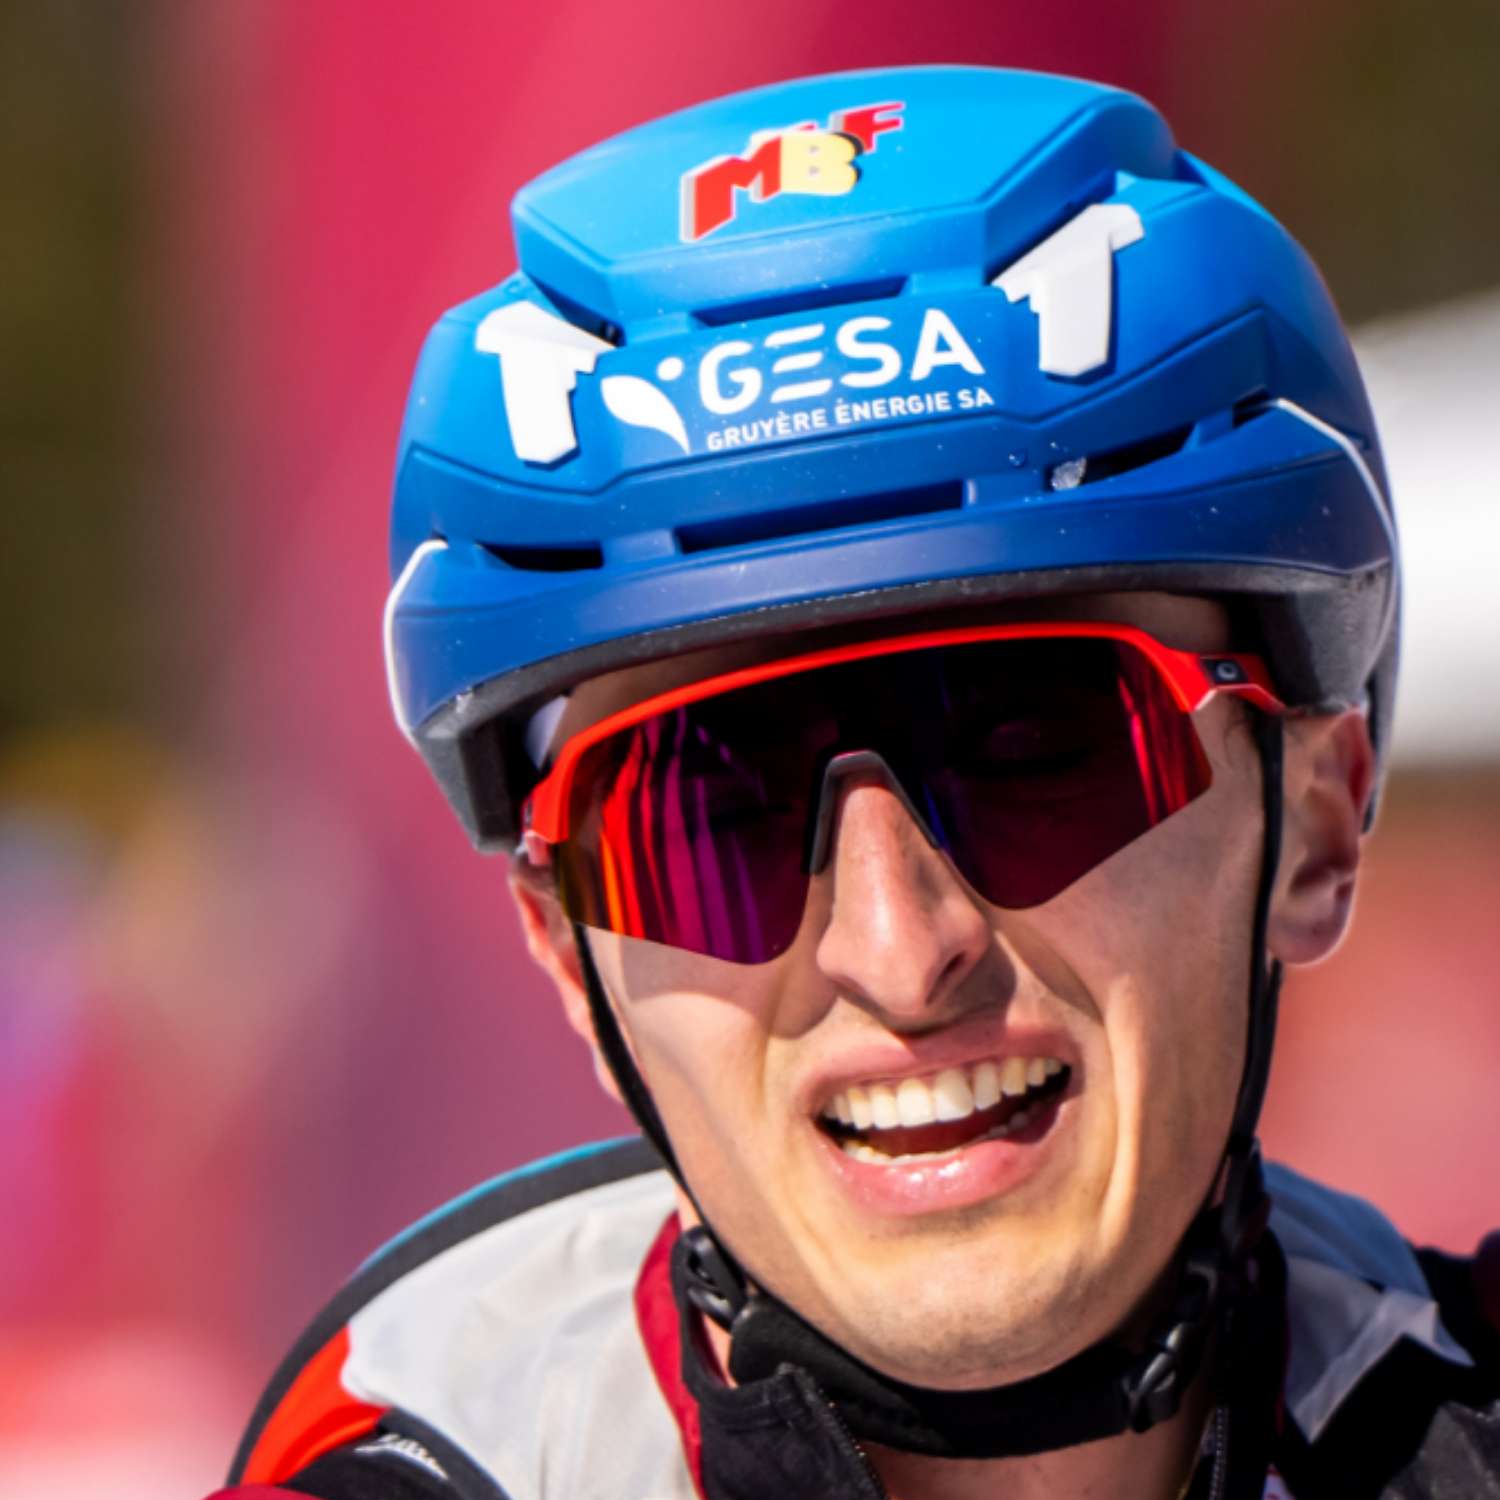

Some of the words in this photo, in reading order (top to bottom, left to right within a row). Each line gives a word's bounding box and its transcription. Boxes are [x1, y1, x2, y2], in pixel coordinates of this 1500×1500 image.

[698, 307, 986, 416] GESA
[706, 408, 828, 452] GRUYÈRE
[836, 391, 952, 427] ÉNERGIE
[959, 390, 994, 409] SA
